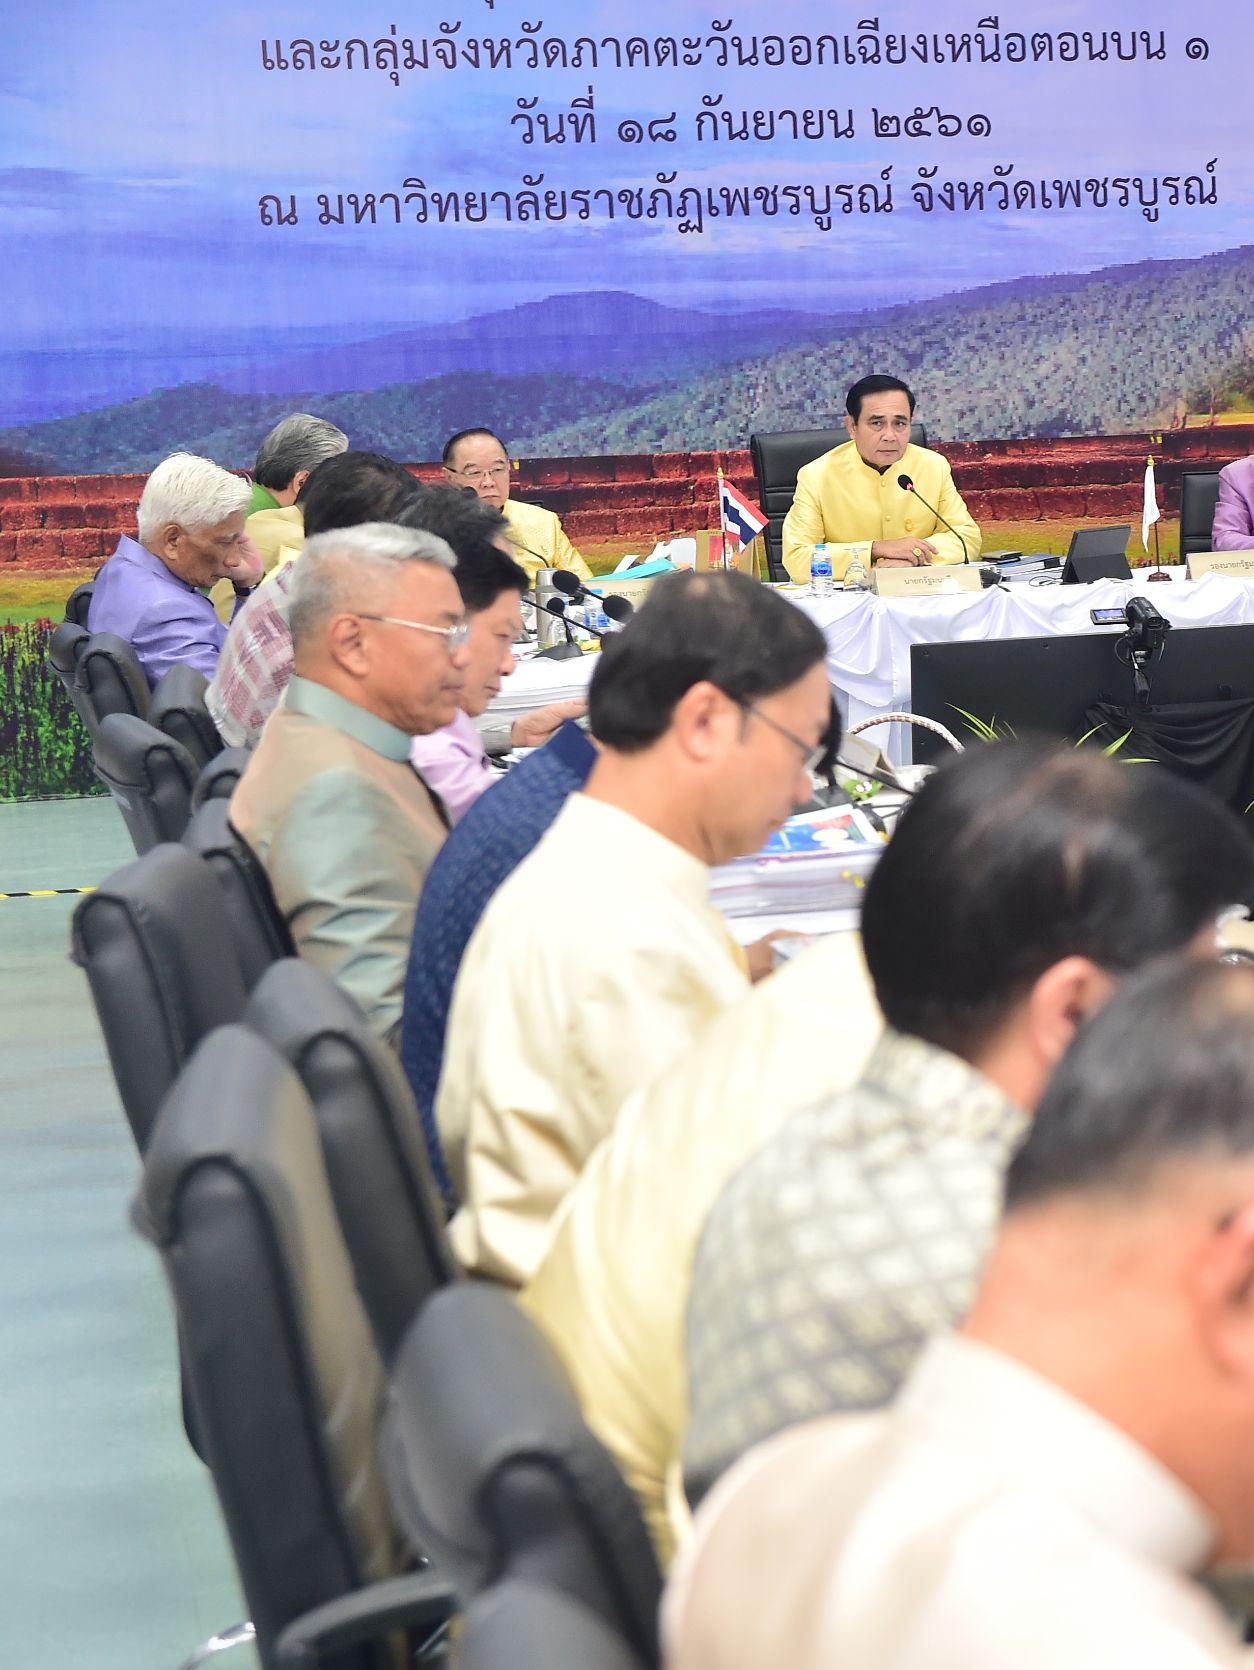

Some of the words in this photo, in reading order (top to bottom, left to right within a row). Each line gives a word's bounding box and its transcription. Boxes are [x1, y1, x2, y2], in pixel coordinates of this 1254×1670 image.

[261, 15, 1166, 87] และกลุ่มจังหวัดภาคตะวันออกเฉียงเหนือตอนบน
[1185, 37, 1209, 61] ๑
[510, 85, 597, 145] วันที่
[617, 110, 677, 144] ๑๘
[695, 94, 855, 142] กันยายน
[871, 106, 992, 139] ๒๕๖๑
[258, 194, 299, 226] ณ
[317, 165, 894, 234] มหาวิทยาลัยราชภัฏเพชรบูรณ์
[910, 157, 1218, 224] จังหวัดเพชรบูรณ์
